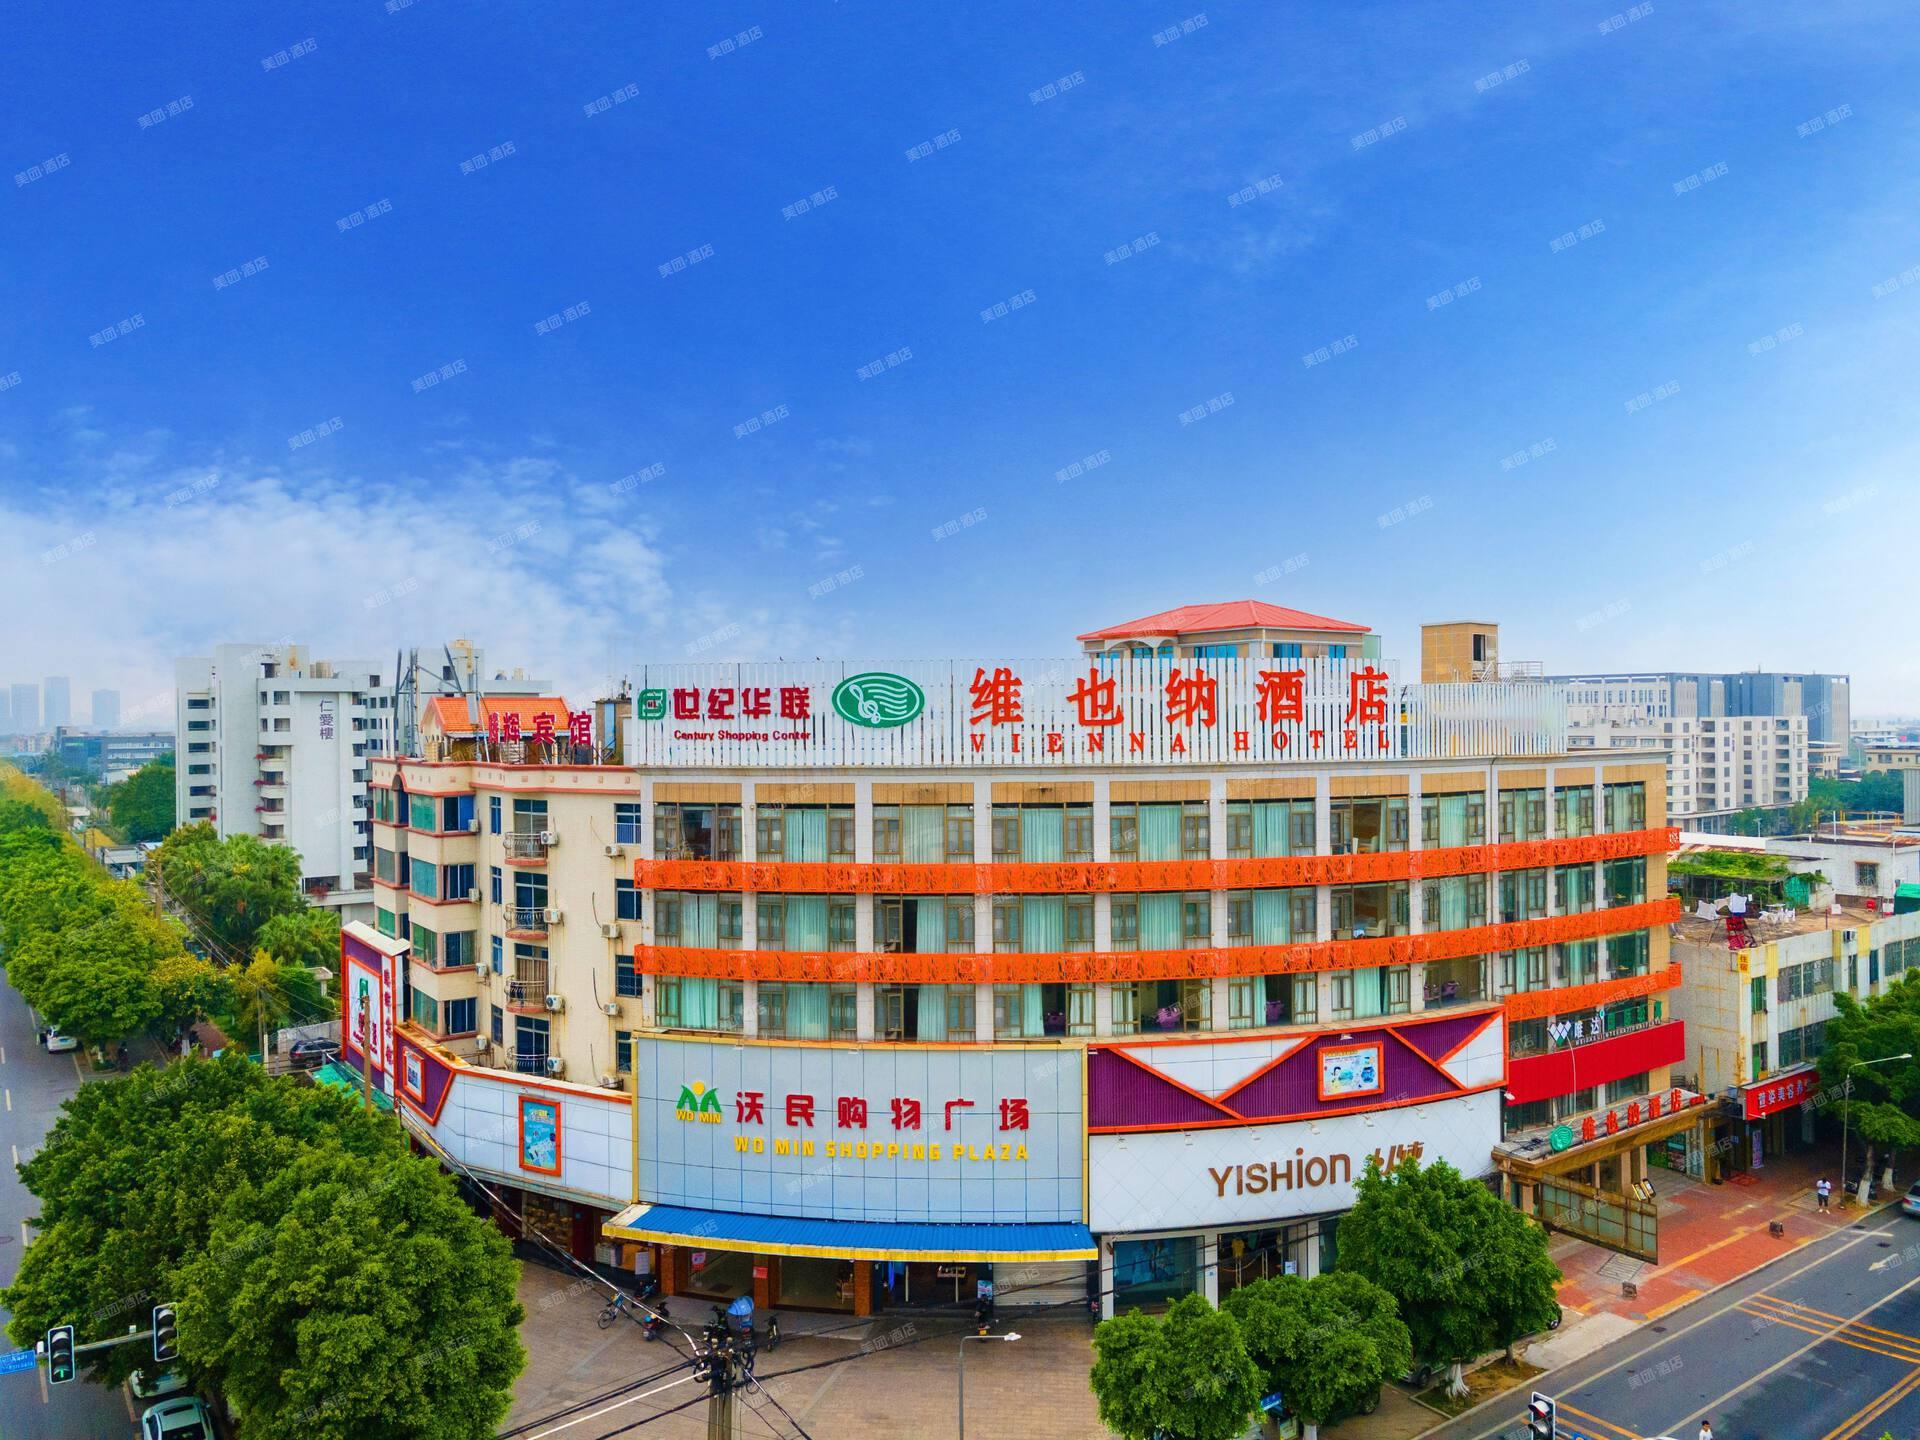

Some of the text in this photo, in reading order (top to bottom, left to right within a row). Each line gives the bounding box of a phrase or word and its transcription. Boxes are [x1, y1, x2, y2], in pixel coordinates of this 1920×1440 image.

[673, 687, 810, 720] 世纪华联
[969, 666, 1390, 728] 维也纳酒店
[674, 730, 714, 741] Century
[718, 730, 768, 741] Shopping
[970, 729, 1390, 754] VIENNA HOTEL
[676, 1110, 722, 1125] WO MIN
[734, 1090, 1031, 1132] 沃民购物广场
[734, 1136, 1029, 1161] WO MIN SHOPPING PLAZA
